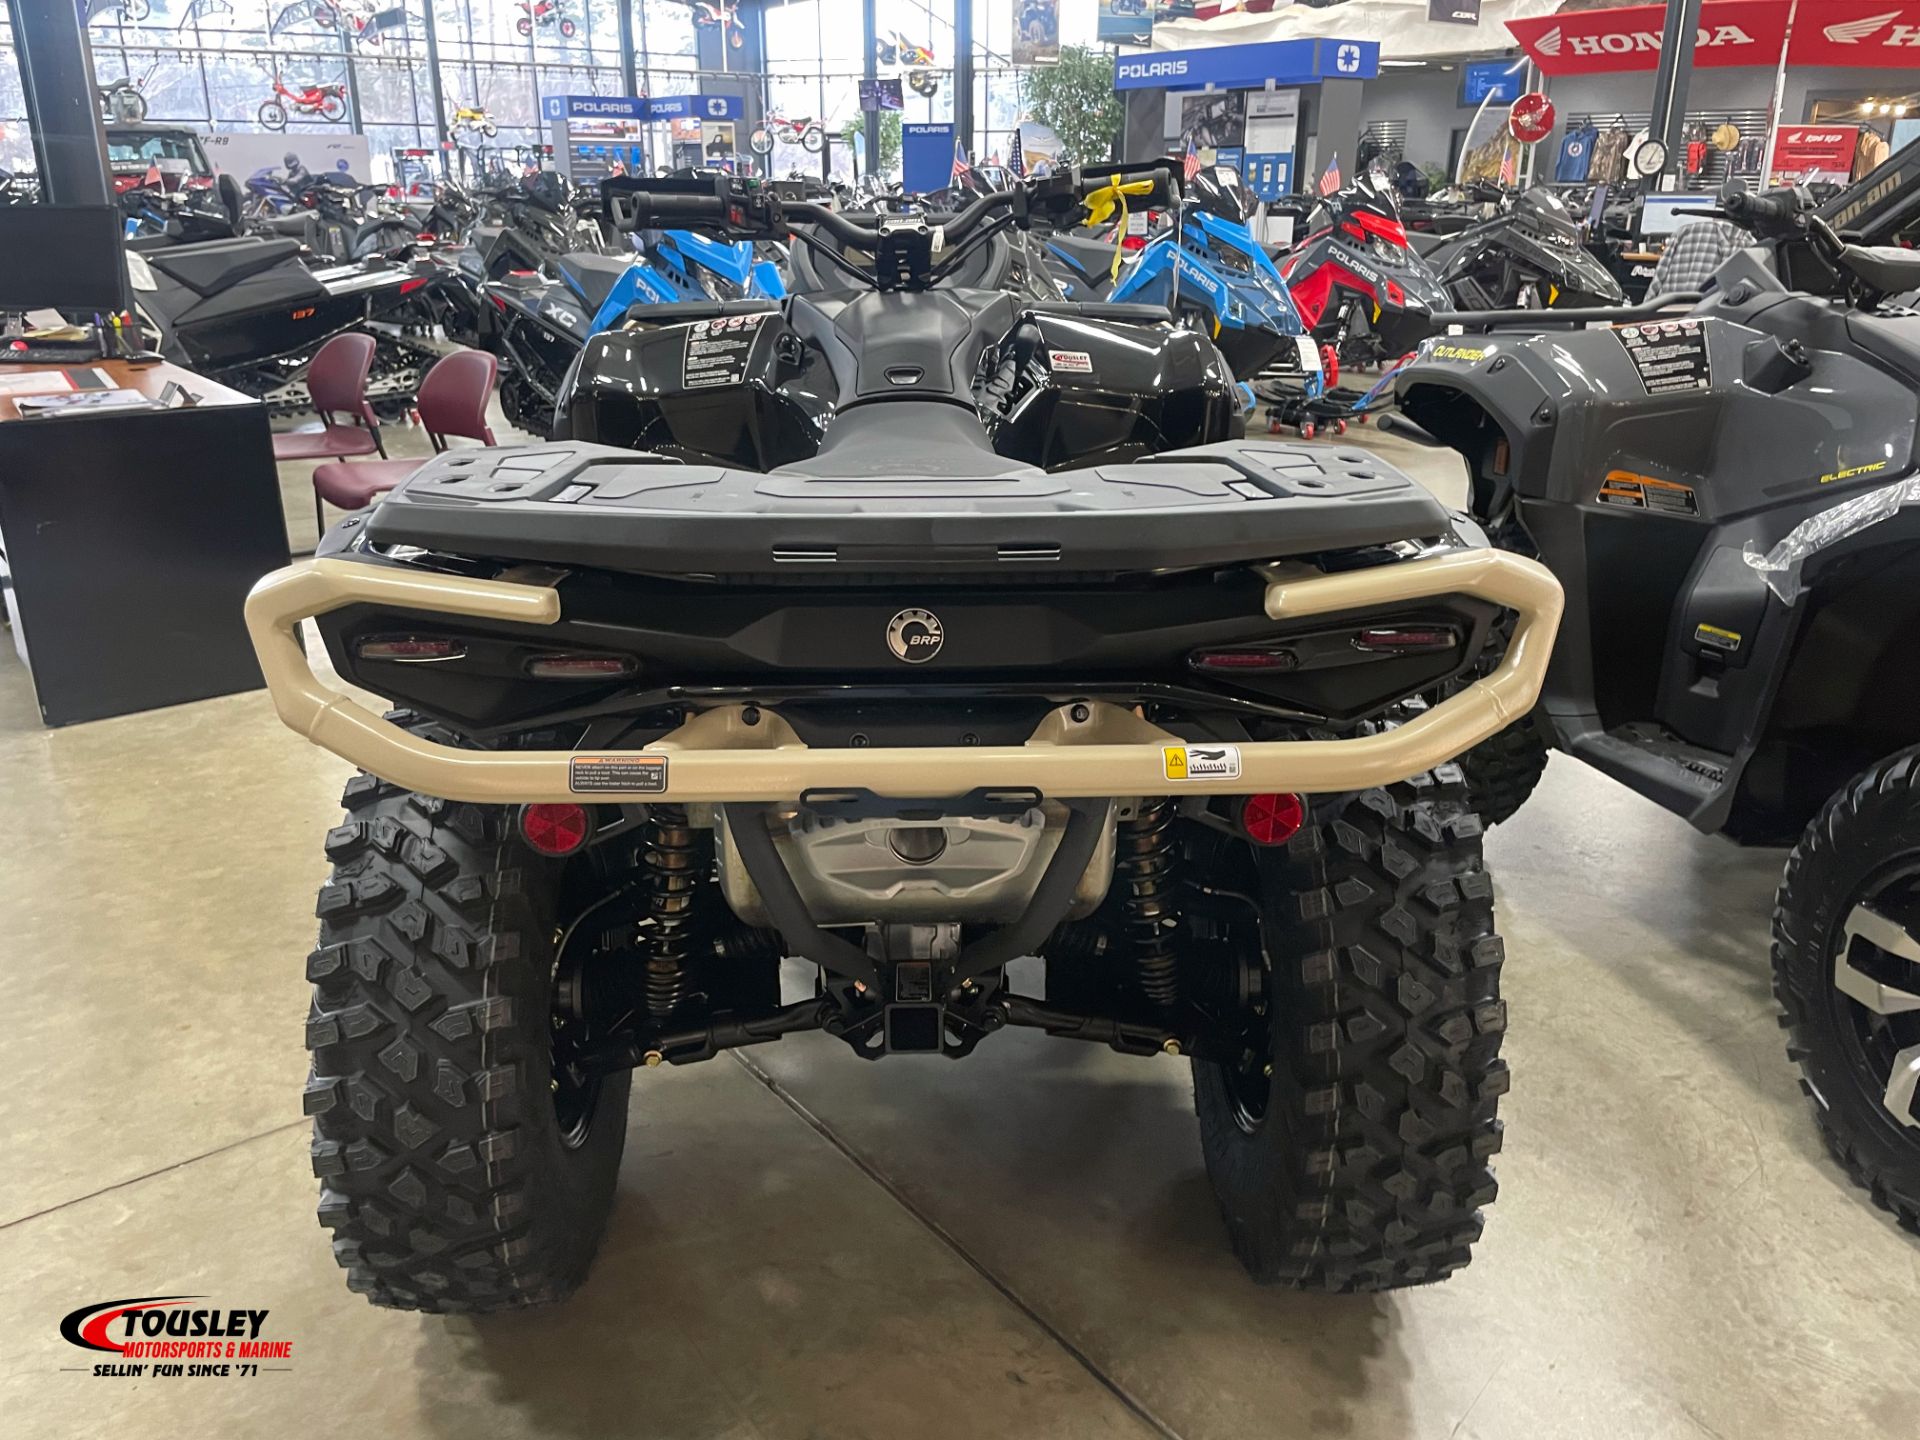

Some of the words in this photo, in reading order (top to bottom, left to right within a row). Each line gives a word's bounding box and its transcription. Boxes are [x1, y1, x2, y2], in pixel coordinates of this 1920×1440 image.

[1119, 60, 1188, 79] POLARIS
[573, 102, 633, 114] POLARIS
[650, 103, 682, 114] POLARIS
[1328, 246, 1378, 283] POLARIS
[545, 302, 577, 328] XC
[1433, 345, 1486, 362] OUTLANDER
[1820, 461, 1887, 483] ELECTRIC
[910, 635, 940, 645] BRP
